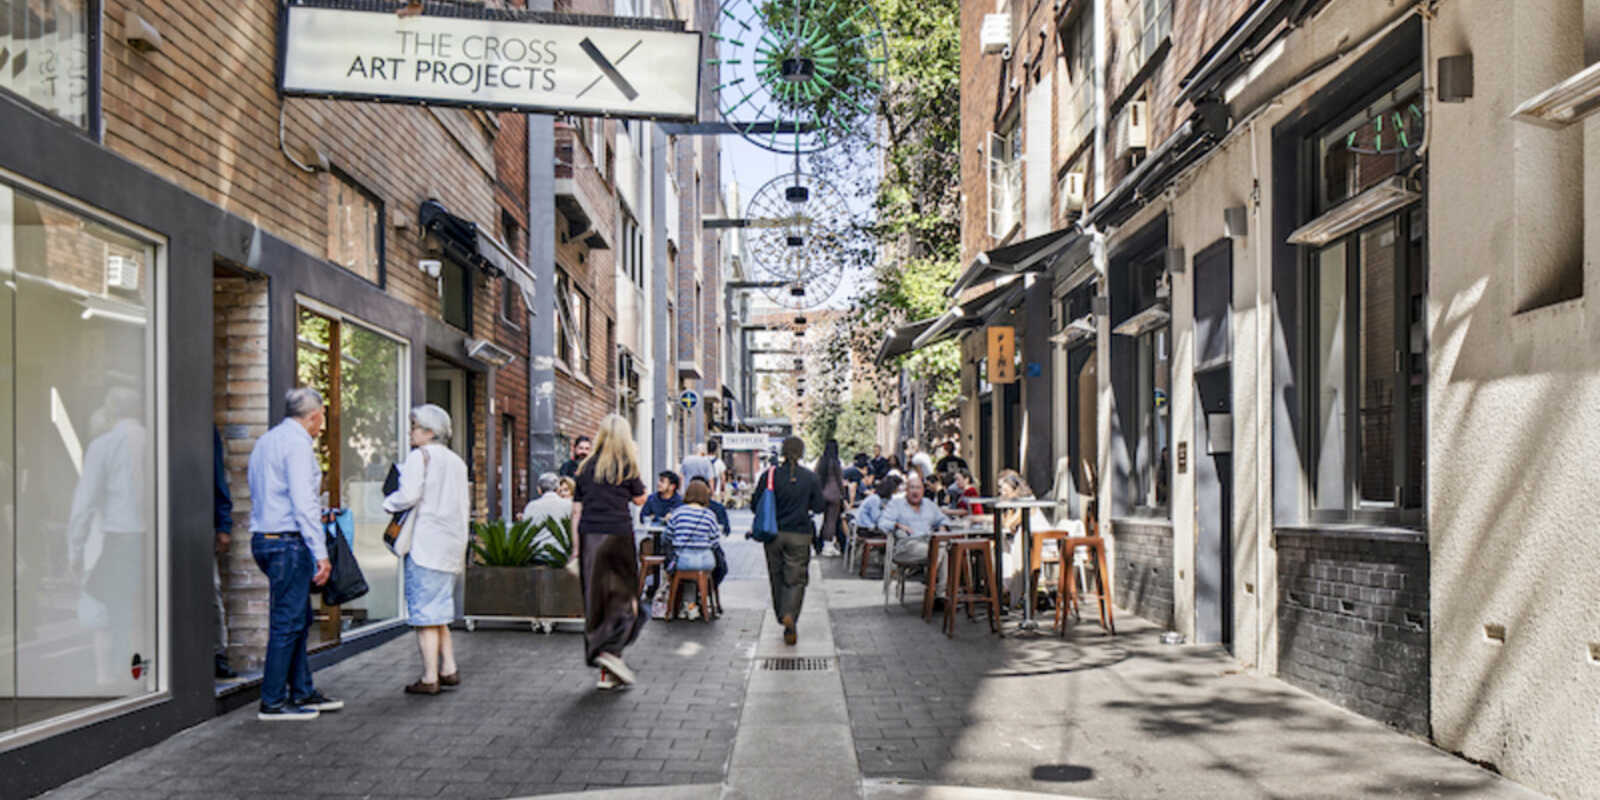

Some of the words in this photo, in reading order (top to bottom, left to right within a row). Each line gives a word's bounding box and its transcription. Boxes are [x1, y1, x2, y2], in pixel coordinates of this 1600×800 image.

[396, 30, 453, 58] THE
[462, 35, 558, 65] CROSS
[347, 55, 405, 80] ART
[415, 59, 556, 93] PROJECTS
